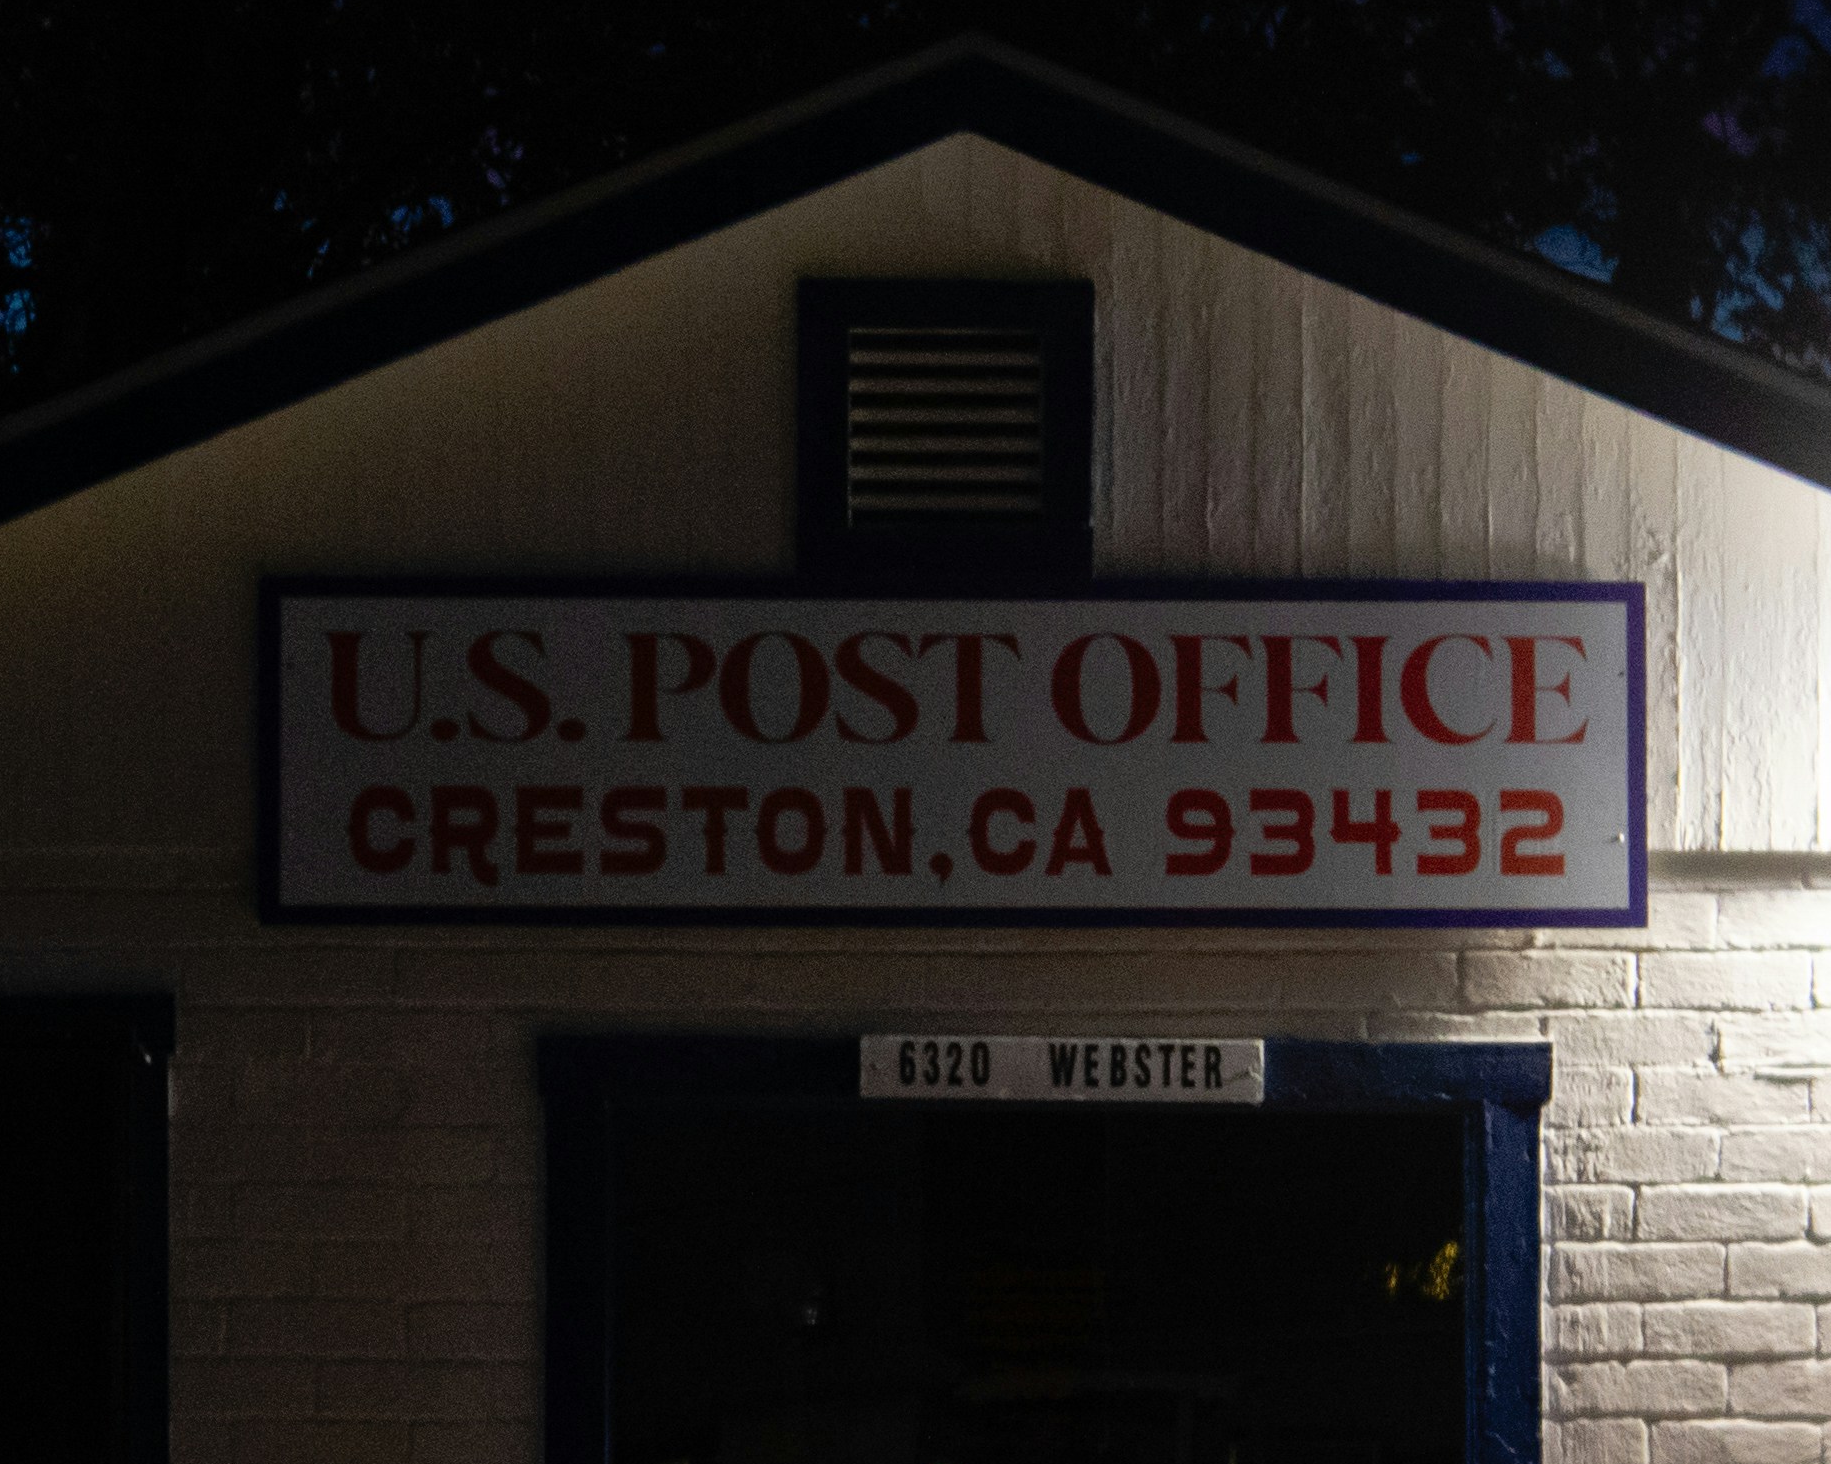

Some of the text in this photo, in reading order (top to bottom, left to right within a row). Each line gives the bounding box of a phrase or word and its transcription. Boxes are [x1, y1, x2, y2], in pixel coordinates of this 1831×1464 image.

[327, 632, 1589, 746] U.S. POST OFFICE
[1166, 788, 1566, 876] 93432
[899, 1041, 1222, 1089] 6320 WEBSTER
